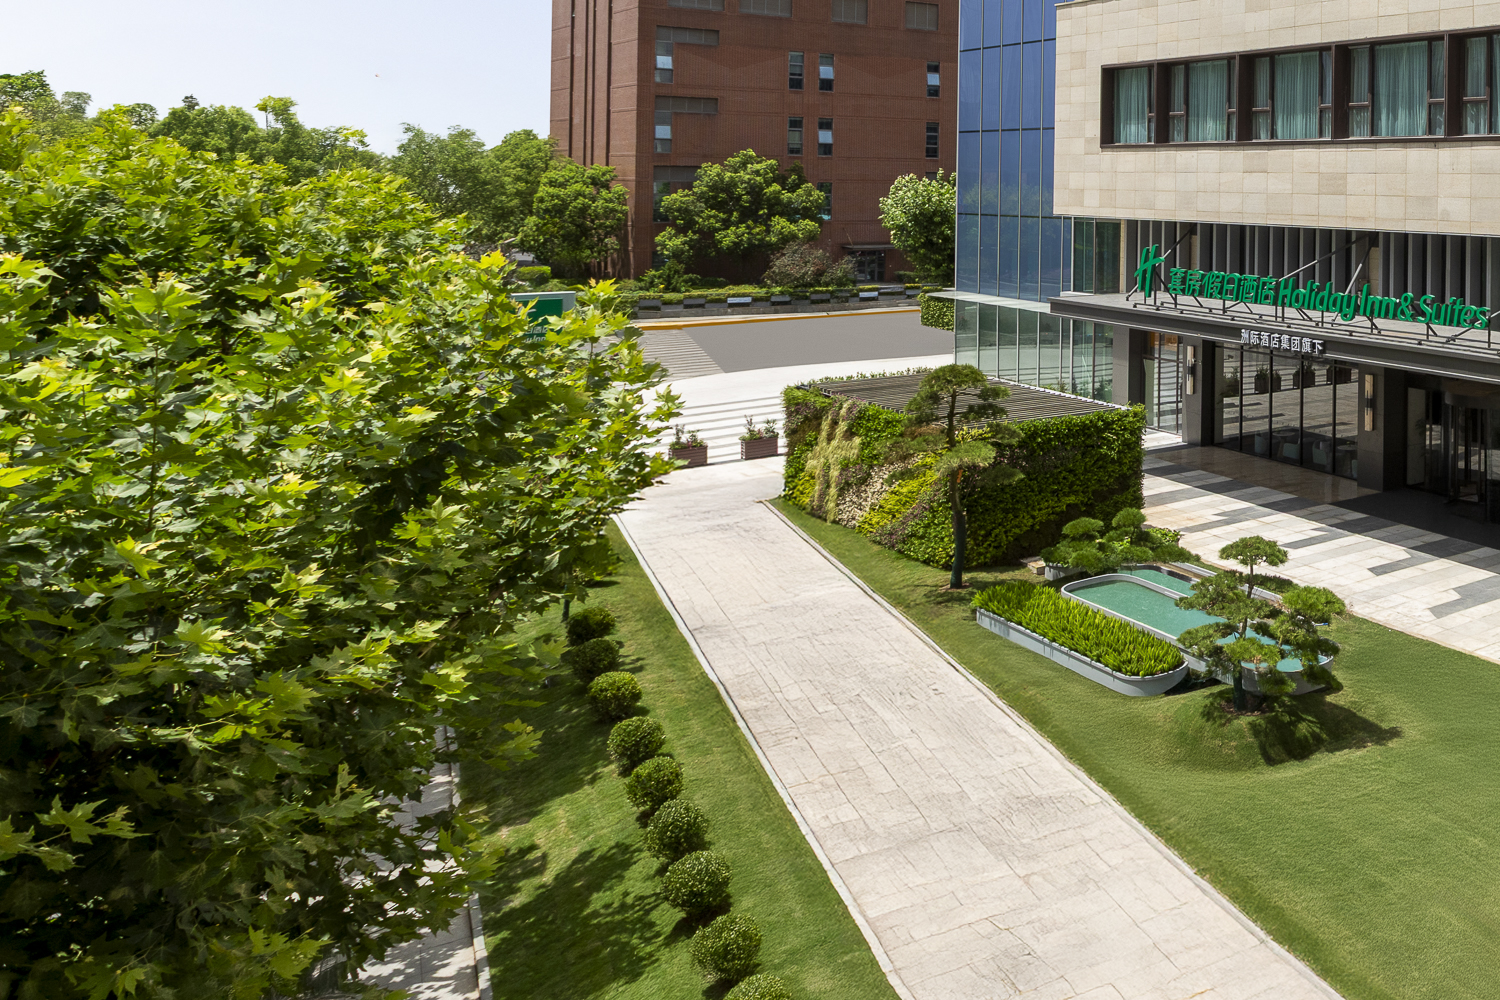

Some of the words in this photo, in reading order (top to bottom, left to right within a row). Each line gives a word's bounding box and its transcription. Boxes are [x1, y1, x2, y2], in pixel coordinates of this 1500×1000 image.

[1168, 267, 1278, 305] 套房假日酒店
[1278, 277, 1358, 321] Holiday
[1417, 294, 1491, 330] Suites
[1240, 328, 1324, 355] 洲际酒店集团旗下
